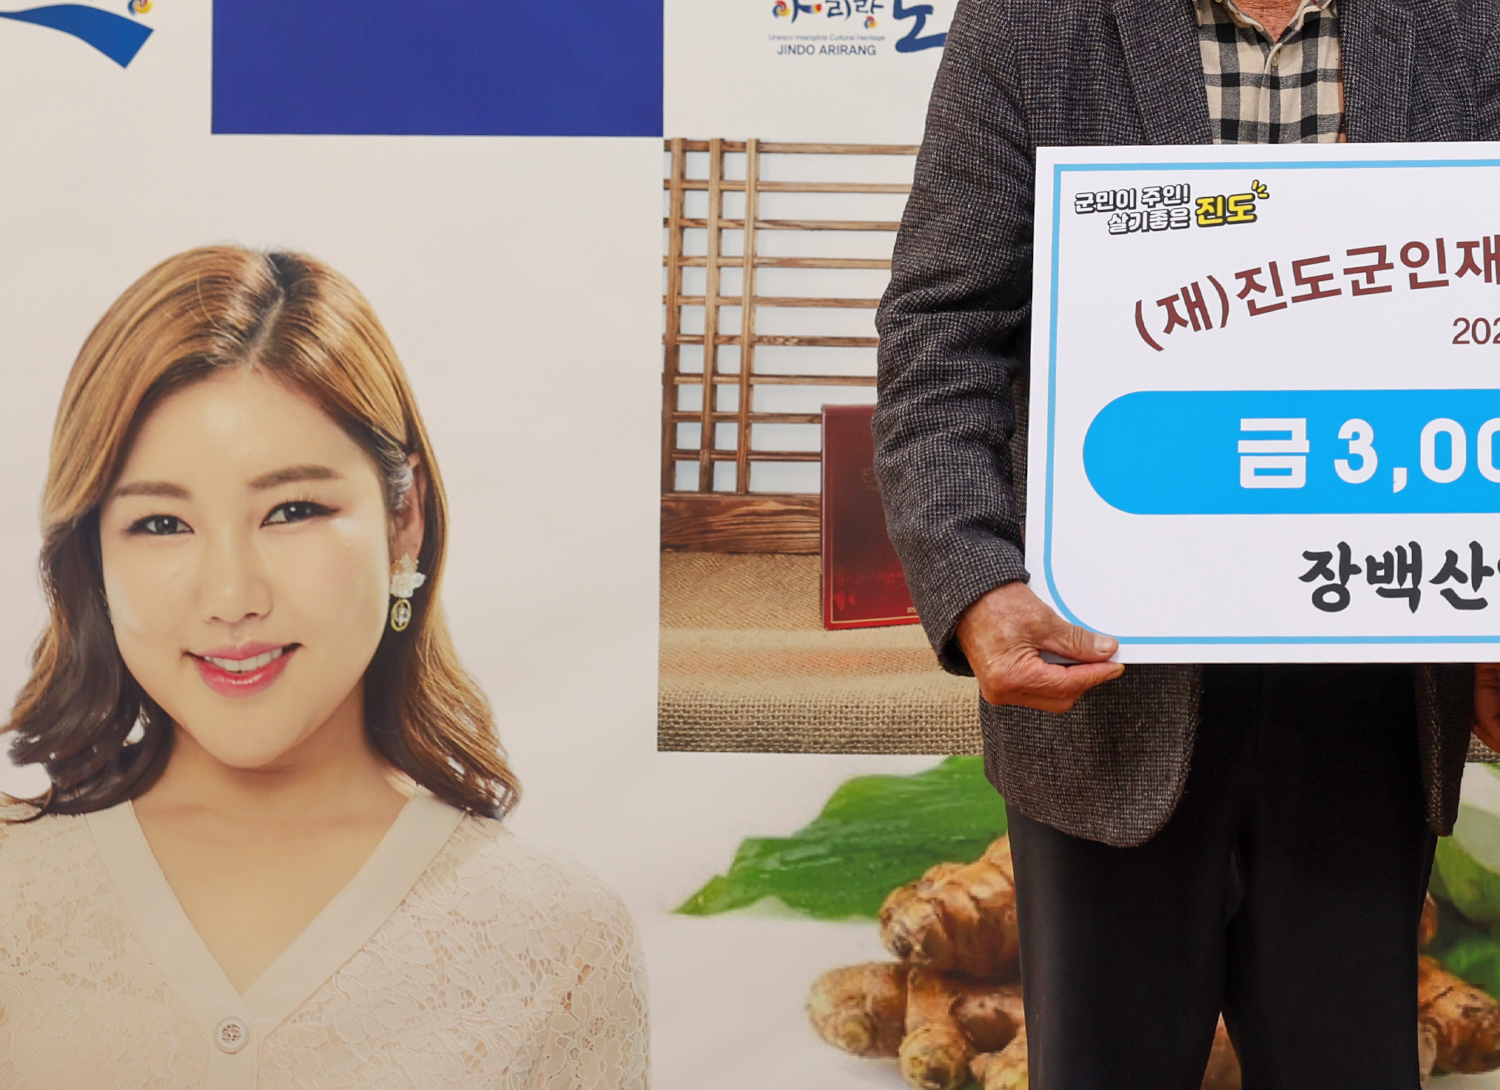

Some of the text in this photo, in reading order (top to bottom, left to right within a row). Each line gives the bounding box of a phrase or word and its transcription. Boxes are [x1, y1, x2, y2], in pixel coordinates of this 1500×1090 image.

[768, 34, 886, 43] Unesco Intangible Cultural Heritage
[777, 45, 877, 56] JINDO ARIRANG
[1074, 183, 1191, 214] 군민이 주인!
[1108, 192, 1258, 235] 살기좋은 진도
[1237, 417, 1310, 489] 금
